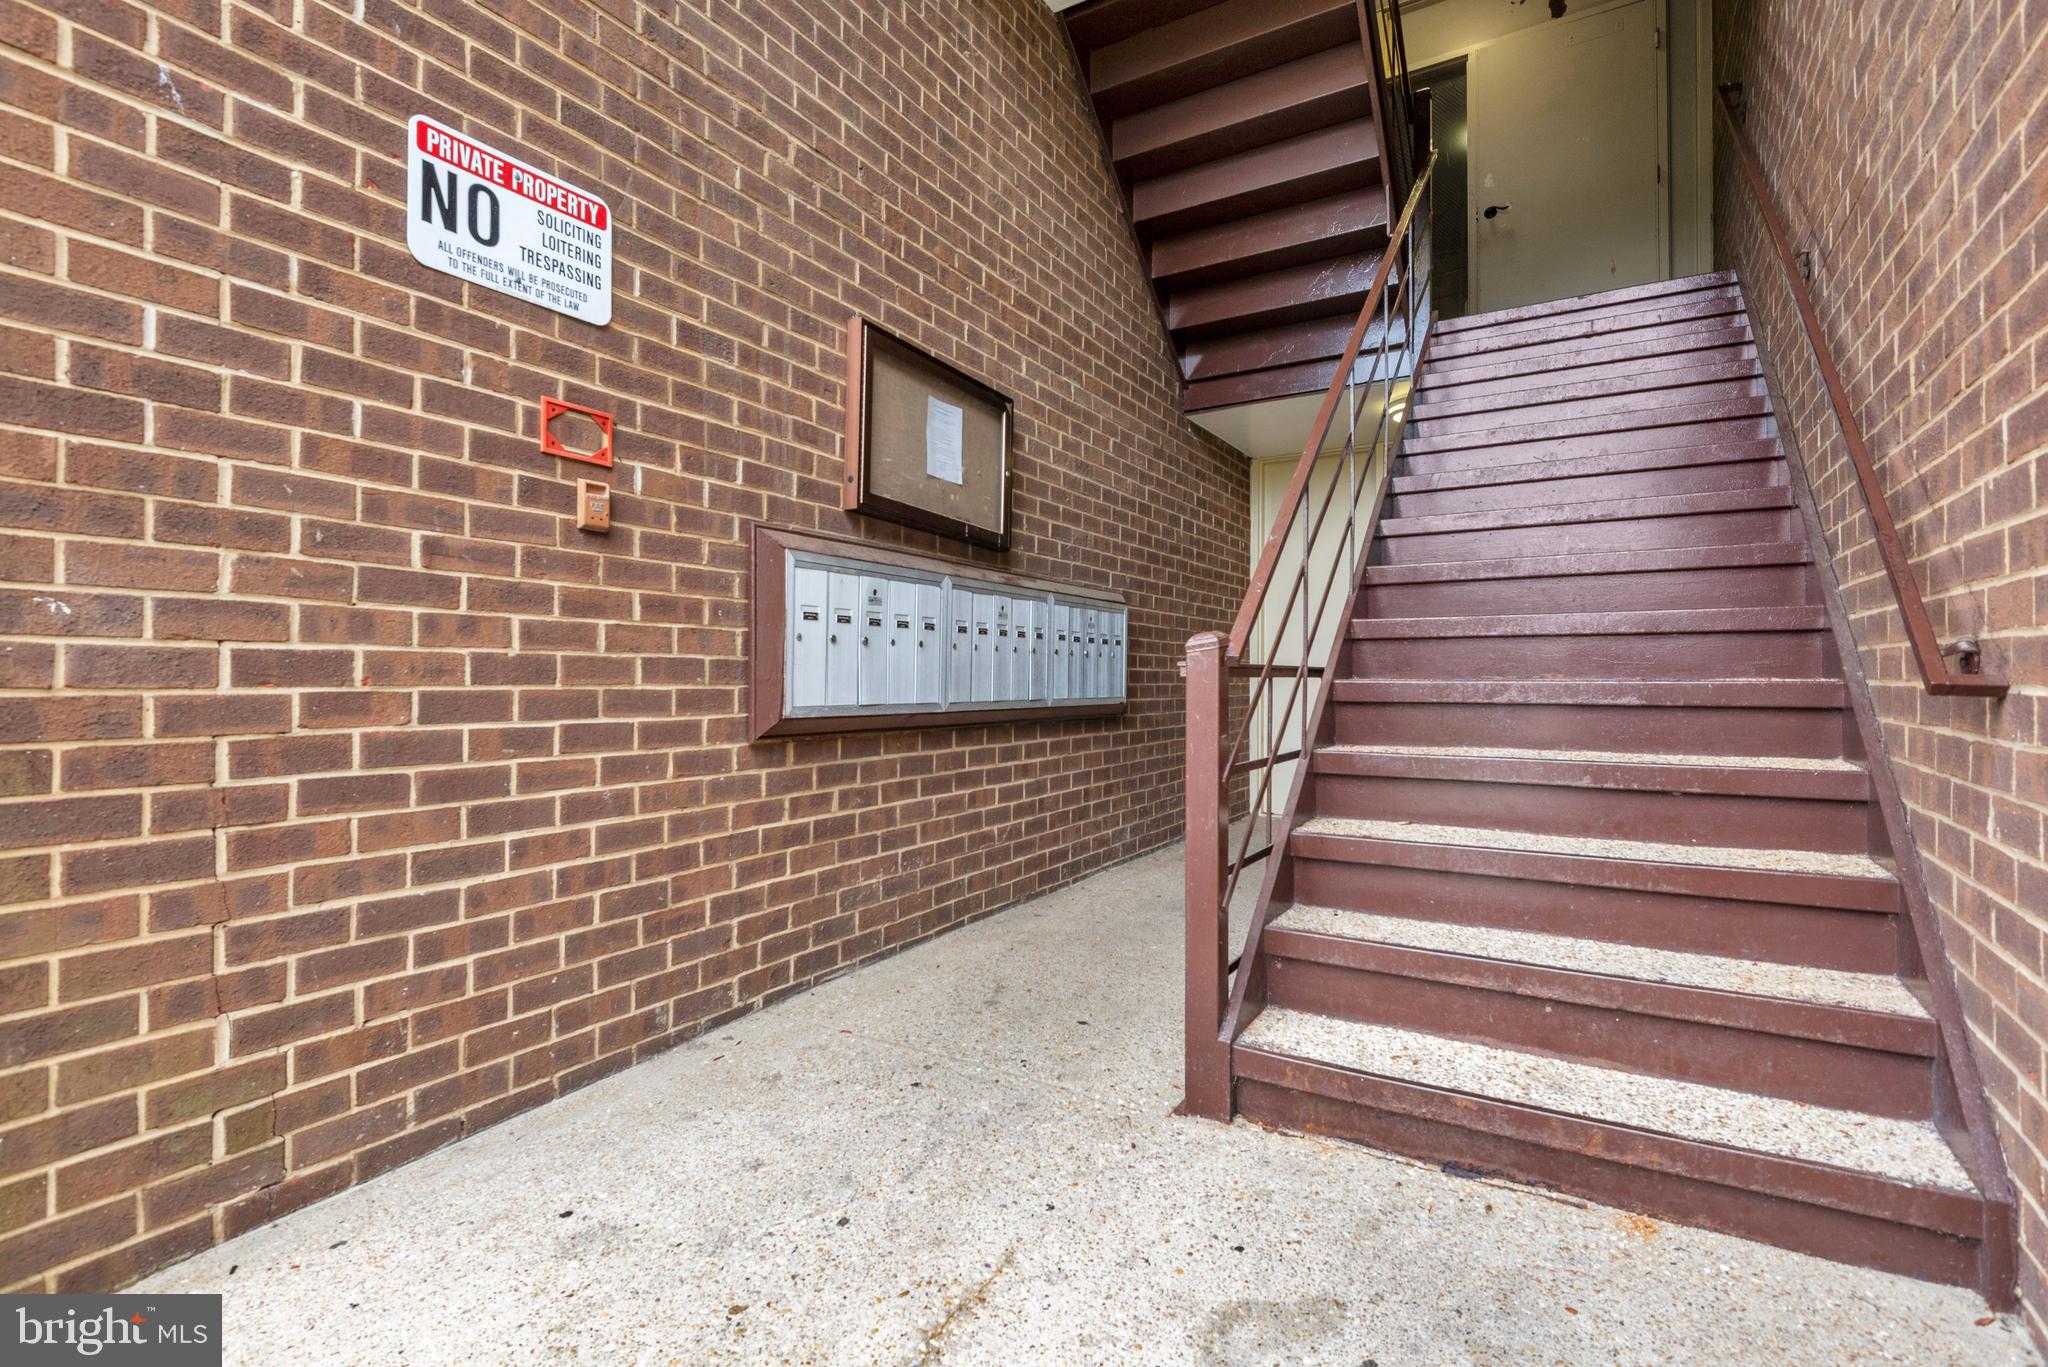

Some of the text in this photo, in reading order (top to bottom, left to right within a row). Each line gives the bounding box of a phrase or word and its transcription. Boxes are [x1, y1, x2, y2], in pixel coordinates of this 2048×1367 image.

[427, 127, 599, 224] PRIVATE PROPERTY
[421, 159, 500, 247] NO
[537, 210, 601, 249] SOLICITING
[438, 240, 588, 303] ALL OFFENDERS WILL BE PROSECUTED
[520, 246, 601, 290] TRESPASSING
[542, 233, 601, 269] LOITERING
[448, 257, 579, 311] TO THE FULL EXTENT OF THE LAW
